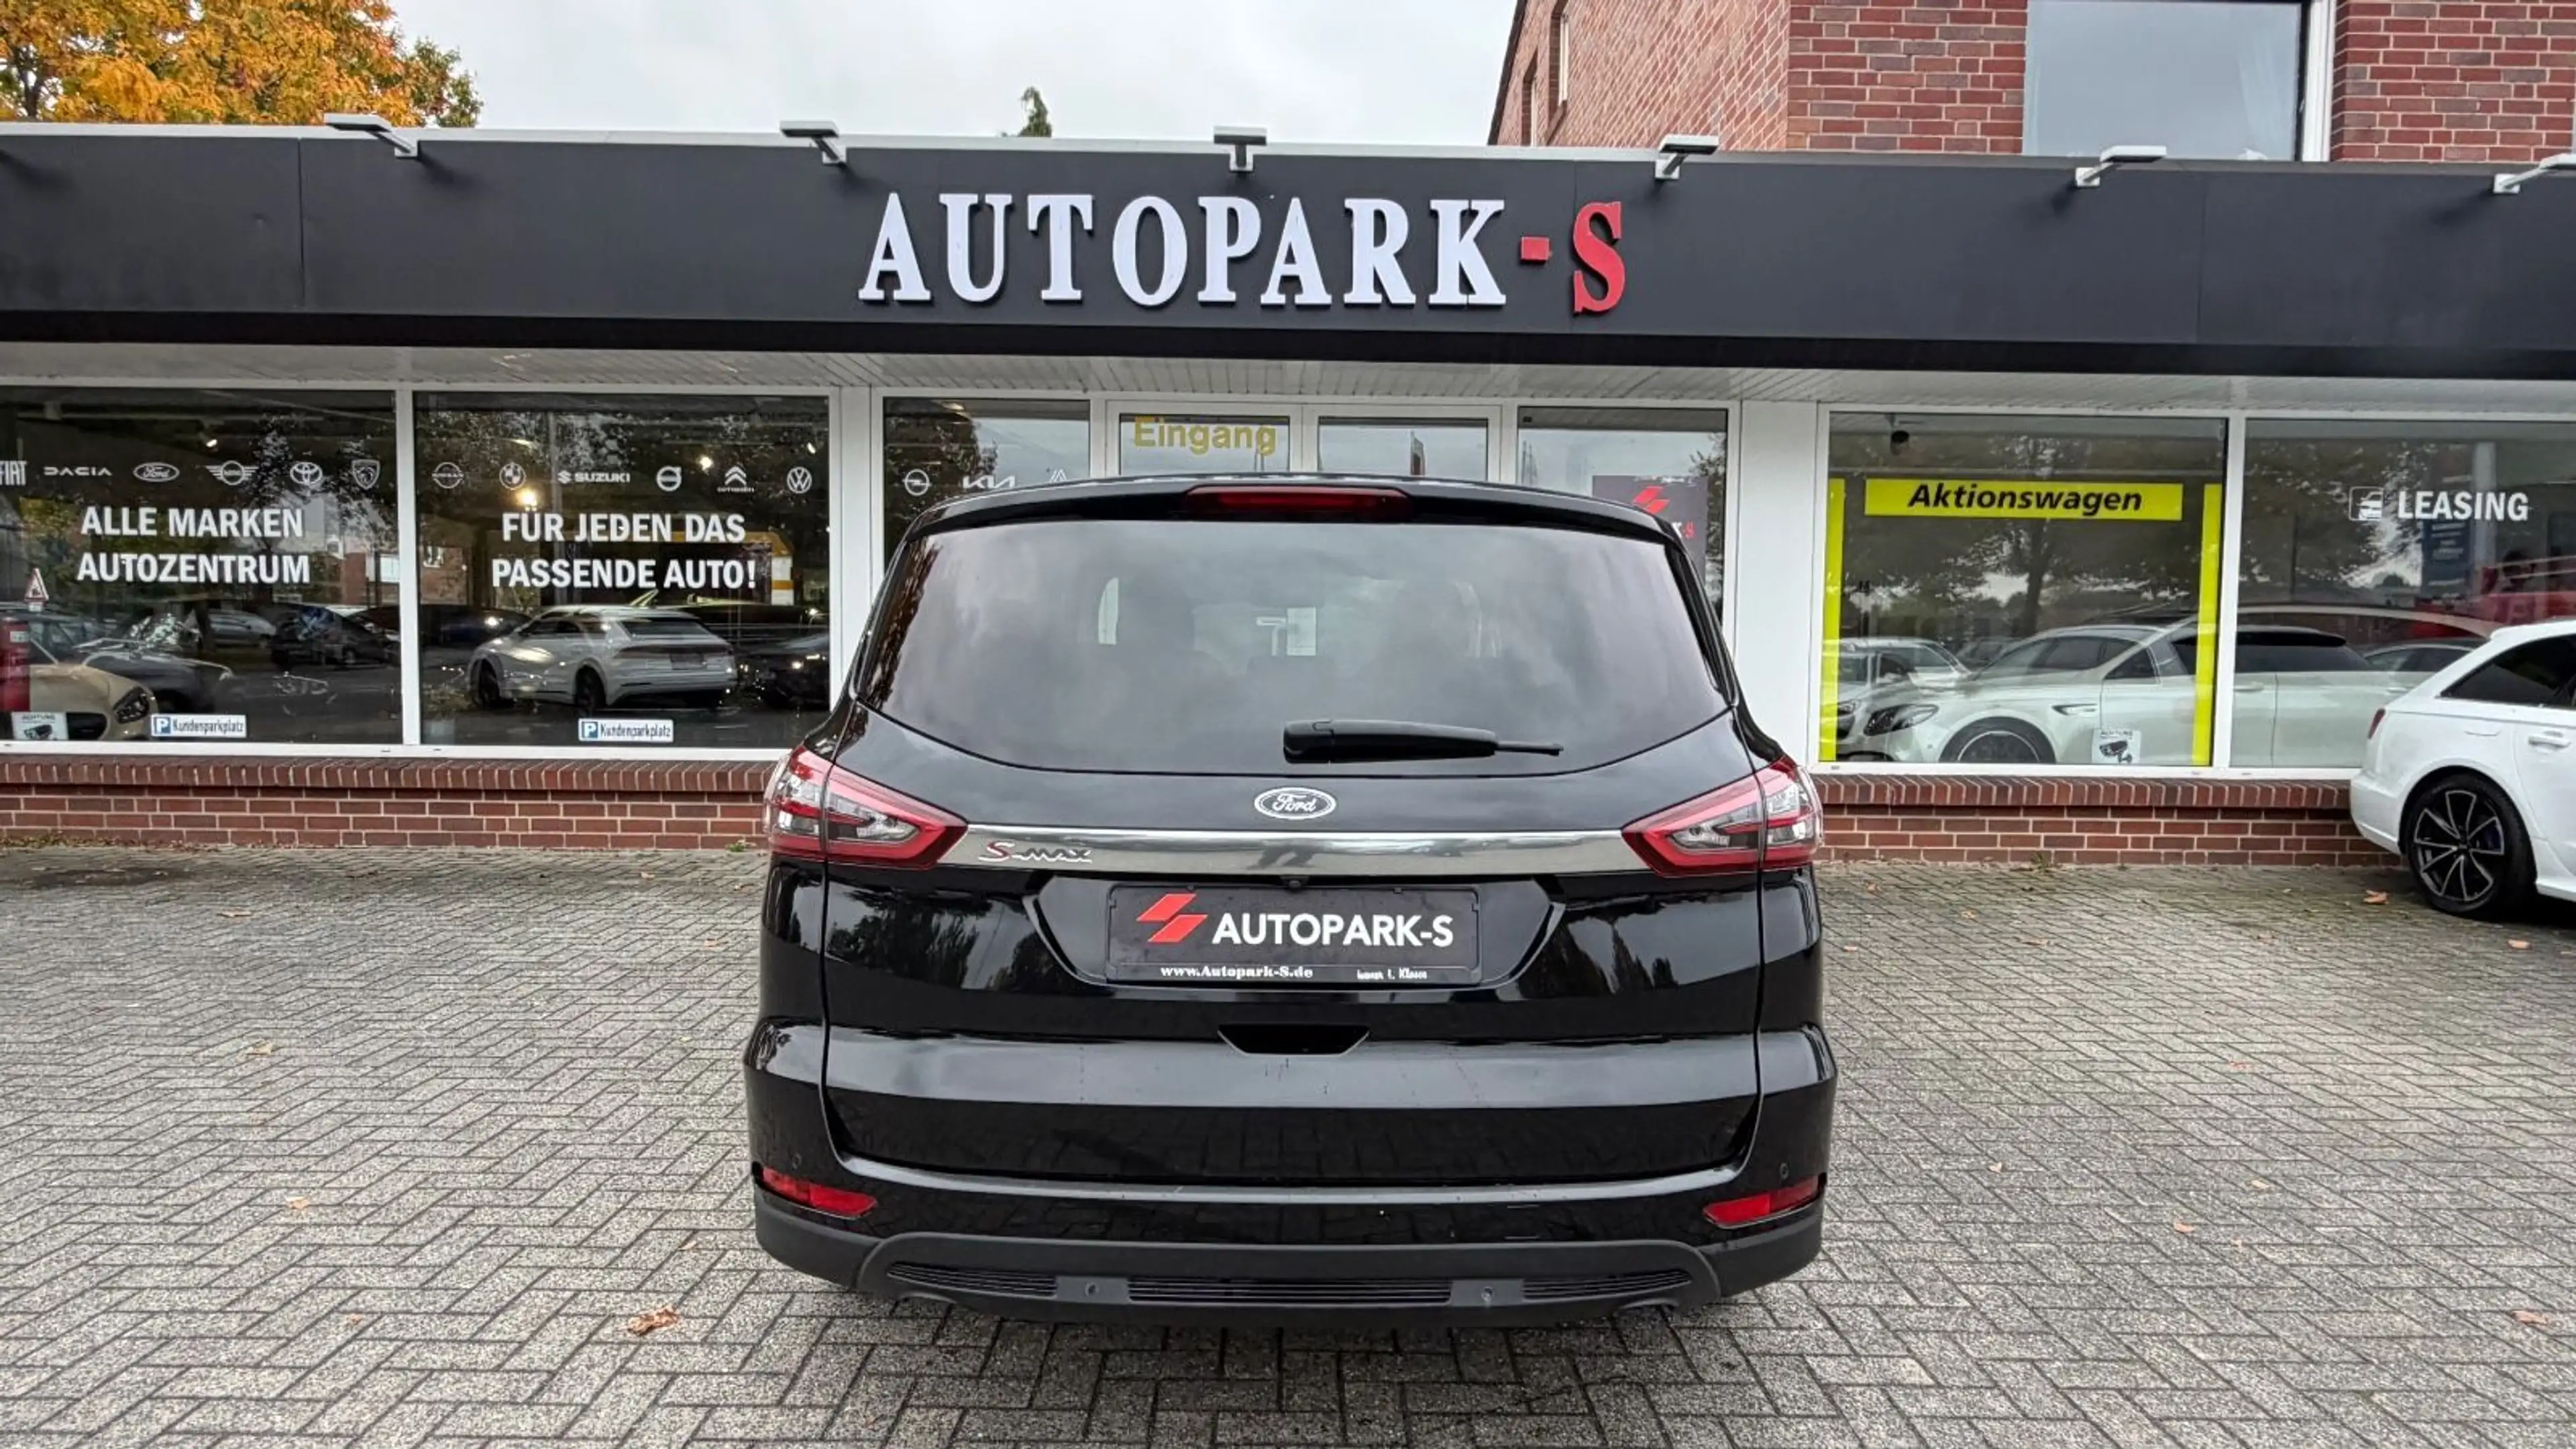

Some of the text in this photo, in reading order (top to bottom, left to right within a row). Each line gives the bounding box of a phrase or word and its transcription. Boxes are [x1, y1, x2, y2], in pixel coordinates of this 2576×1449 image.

[858, 192, 1626, 314] AUTOPARK-S
[1134, 415, 1277, 456] Eingang
[43, 466, 112, 476] DACIA
[574, 472, 630, 483] SUZUKI
[1908, 484, 2143, 516] Aktionswagen
[2398, 490, 2529, 521] LEASING
[80, 506, 303, 537] ALLE MARKEN
[502, 506, 746, 543] FÜR JEDEN DAS
[77, 552, 310, 584] AUTOZENTRUM
[492, 558, 757, 589] PASSENDE AUTO!
[1272, 793, 1316, 812] Ford
[1212, 913, 1454, 947] AUTOPARK-S
[1161, 966, 1313, 979] www.Autopark-S.de
